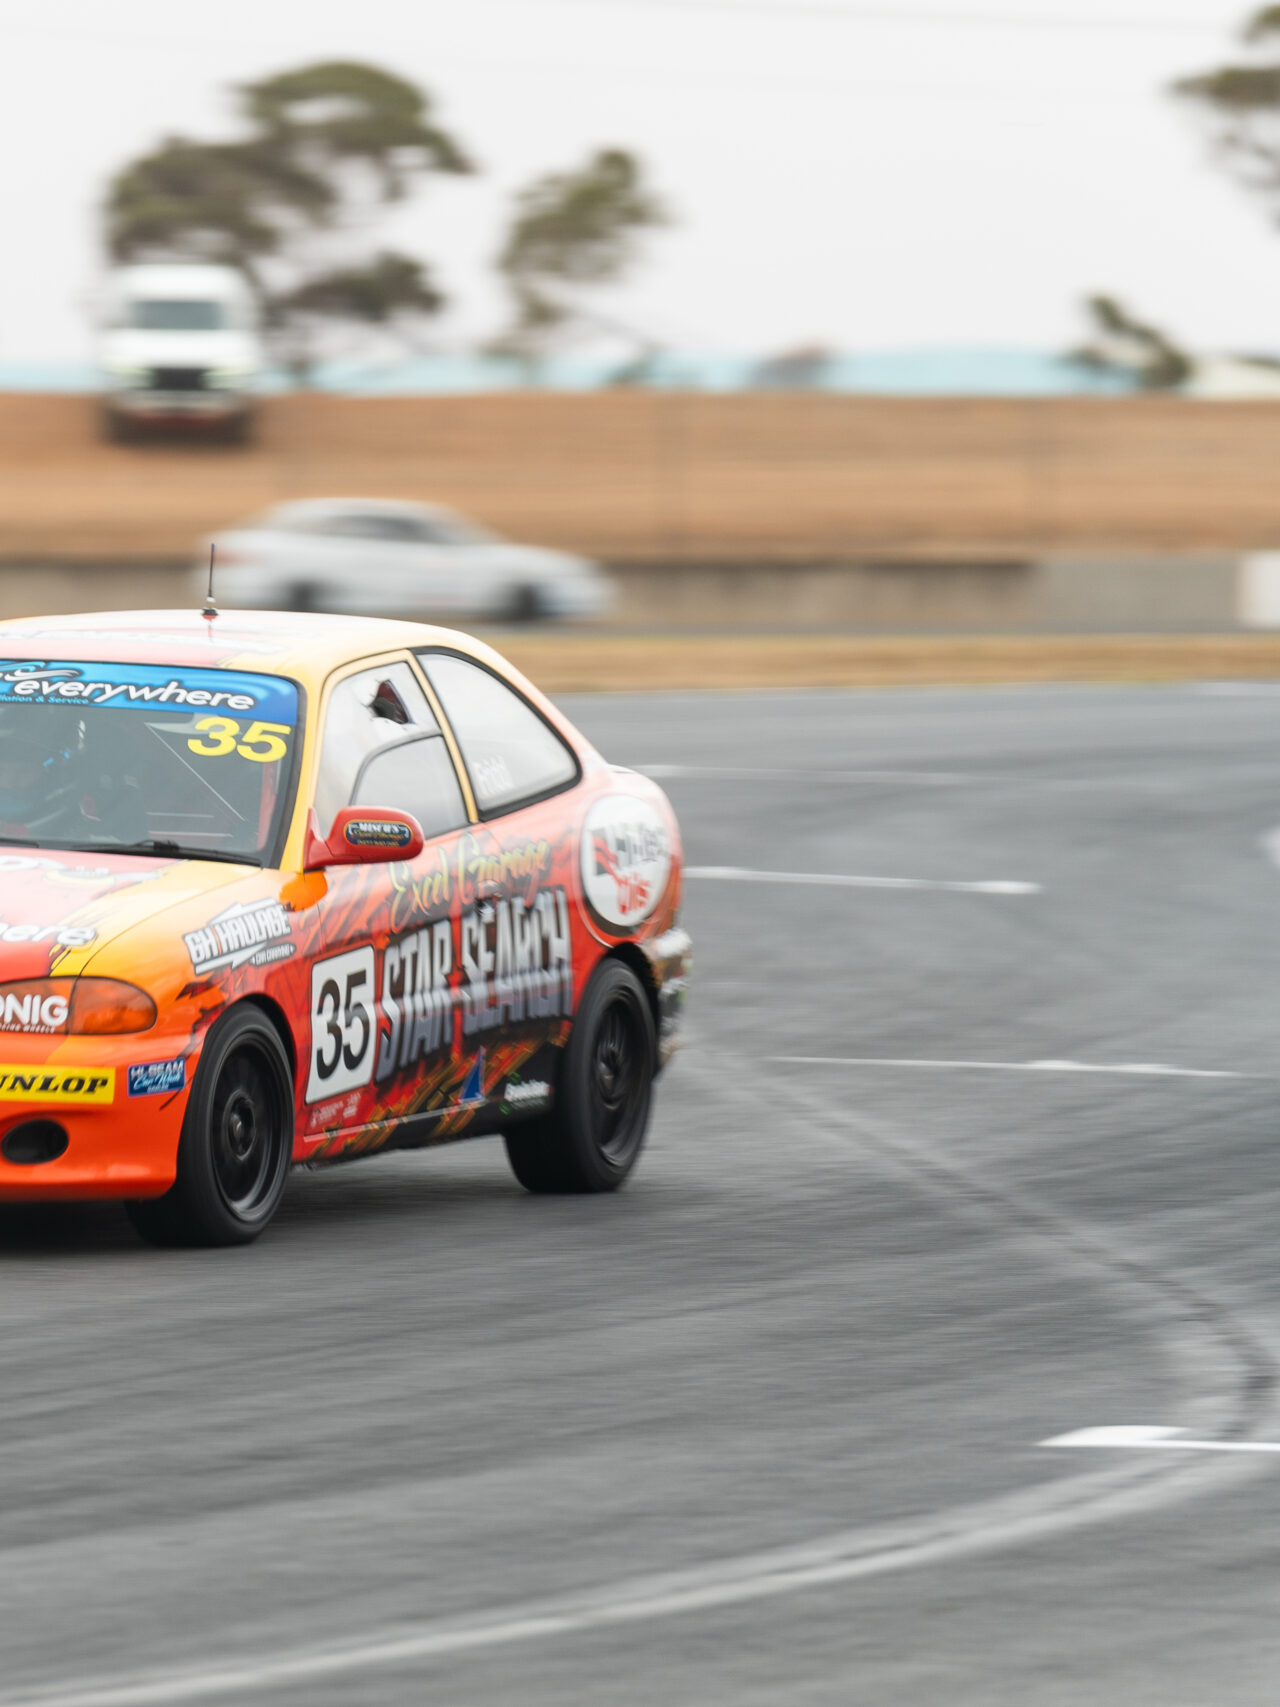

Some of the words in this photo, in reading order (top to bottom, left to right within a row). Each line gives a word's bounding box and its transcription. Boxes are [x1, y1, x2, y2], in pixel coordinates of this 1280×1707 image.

[14, 680, 255, 710] everywhere
[47, 695, 89, 705] Service
[187, 716, 291, 762] 35
[376, 919, 454, 1083] STAR
[461, 889, 573, 1036] SEARCH
[316, 968, 370, 1080] 35
